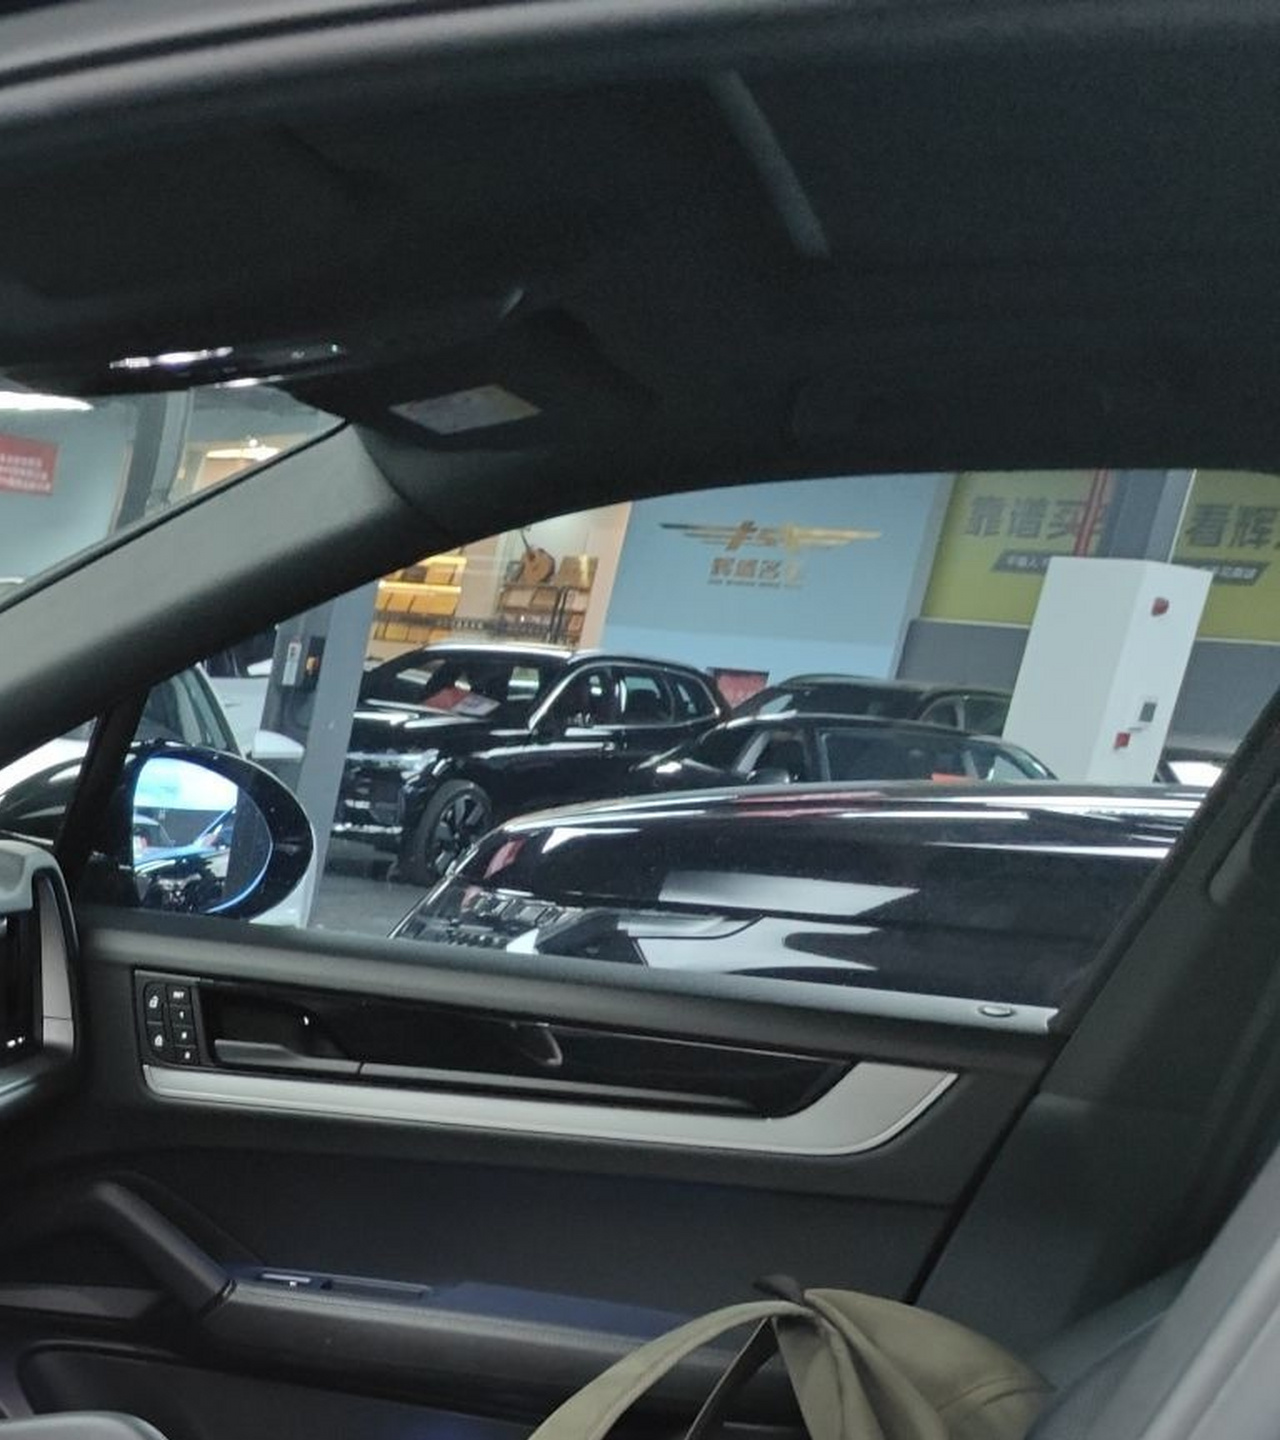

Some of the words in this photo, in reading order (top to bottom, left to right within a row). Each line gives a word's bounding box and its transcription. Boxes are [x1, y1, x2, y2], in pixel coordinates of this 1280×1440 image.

[965, 496, 1102, 541] 靠谱买
[1185, 503, 1280, 549] 看辉
